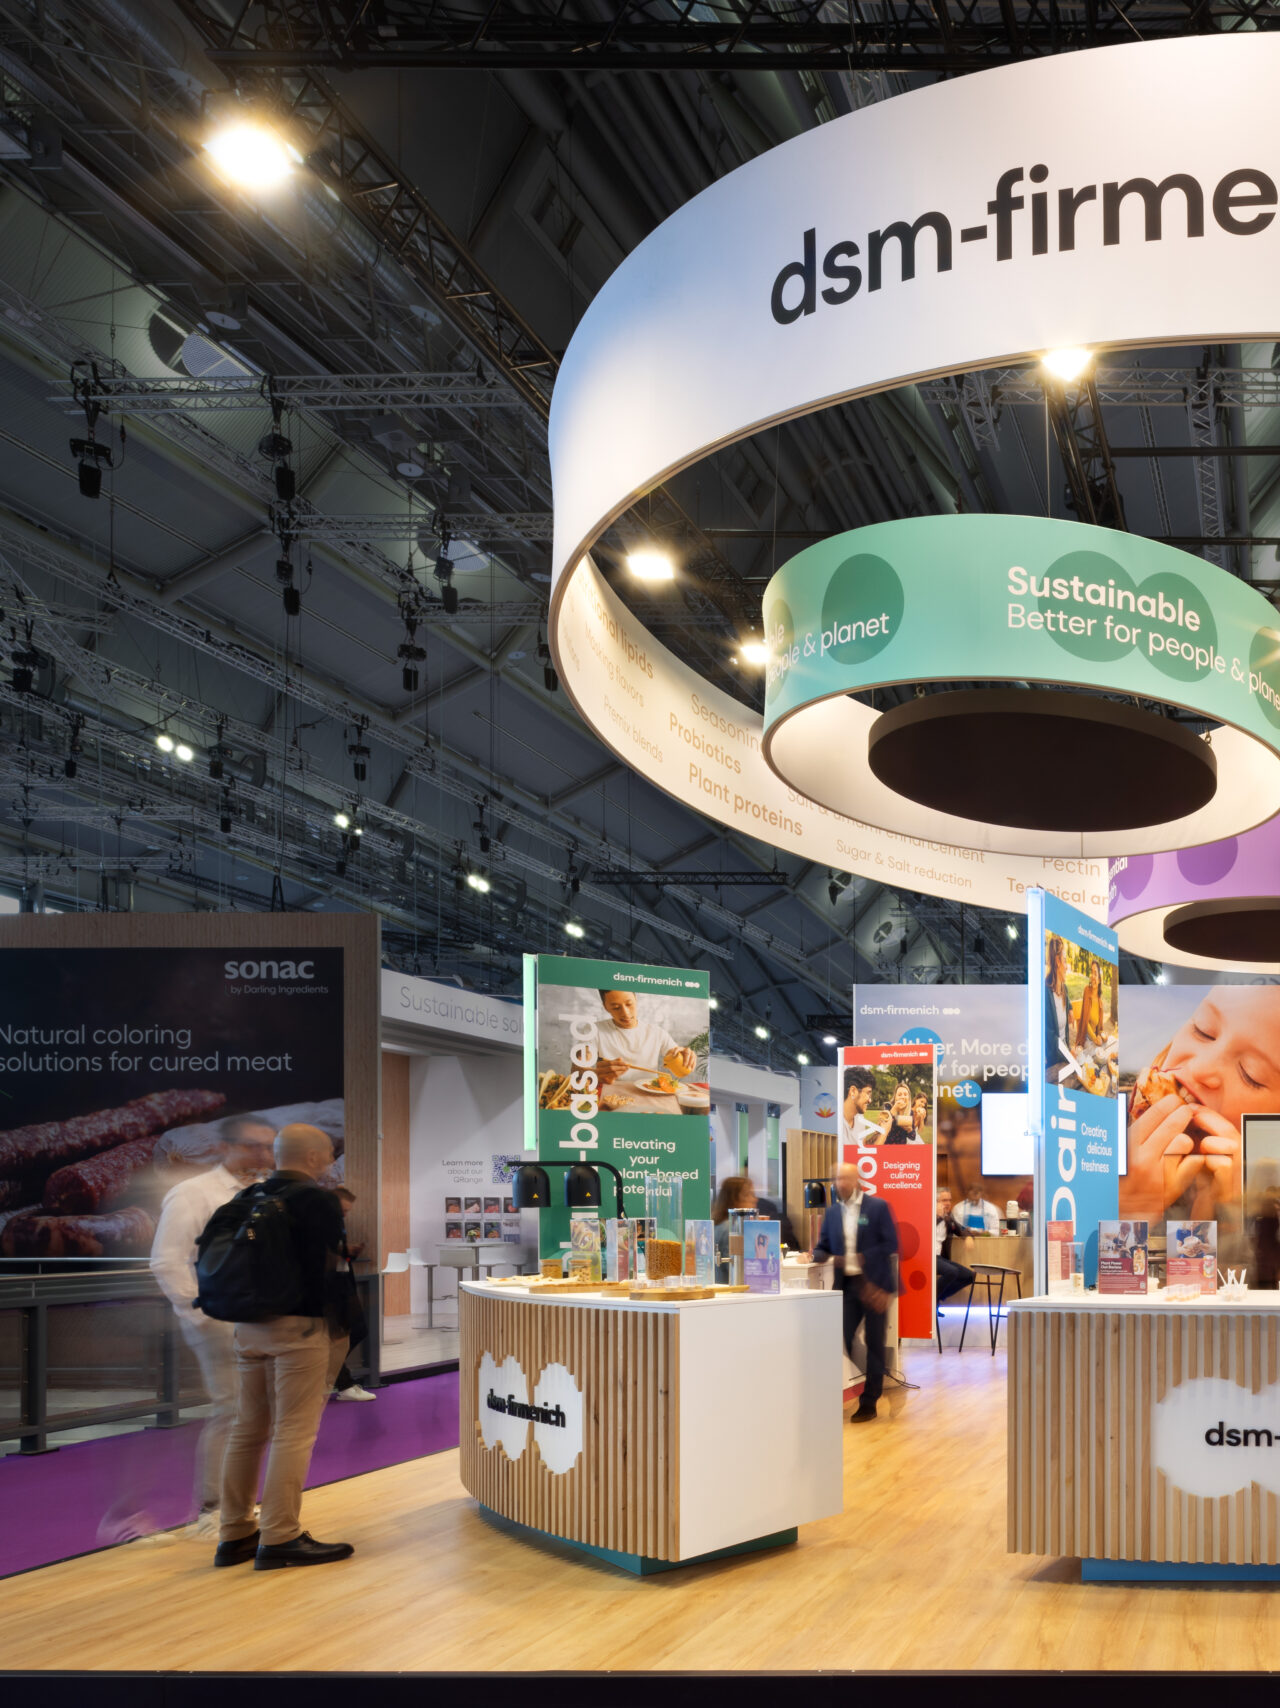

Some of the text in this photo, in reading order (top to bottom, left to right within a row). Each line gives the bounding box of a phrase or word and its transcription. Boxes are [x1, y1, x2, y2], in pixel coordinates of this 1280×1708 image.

[1007, 566, 1201, 632] Sustainable
[803, 633, 816, 657] &
[821, 612, 890, 657] planet
[1007, 603, 1096, 638] Better
[1104, 615, 1142, 646] for
[1149, 631, 1226, 674] people
[1231, 658, 1246, 684] &
[621, 627, 654, 679] lipids
[691, 693, 763, 757] Seasonin
[632, 726, 663, 761] blends
[670, 711, 742, 774] Probiotics
[689, 762, 803, 836] Plant proteins
[836, 839, 972, 888] Sugar & Salt reduction
[1042, 857, 1100, 878] Pectin
[224, 960, 315, 979] sonac
[613, 972, 683, 988] dsm-firmenich
[230, 984, 329, 995] by Darling Ingredients
[400, 985, 498, 1030] Sustainable
[860, 1005, 940, 1015] dsm-firmenich
[0, 1024, 192, 1050] Natural coloring
[961, 1039, 1014, 1055] More
[0, 1050, 293, 1073] solutions for cured meat
[952, 1060, 980, 1076] for
[1051, 1037, 1083, 1236] Dairy
[1080, 1123, 1107, 1141] Creating
[613, 1137, 676, 1153] Elevating
[1086, 1141, 1113, 1157] delicious
[629, 1155, 660, 1167] your
[883, 1161, 920, 1171] Designing
[1081, 1158, 1110, 1174] freshness
[883, 1181, 922, 1190] excellence
[890, 1171, 920, 1180] culinary
[486, 1388, 566, 1428] dsm-firmenich
